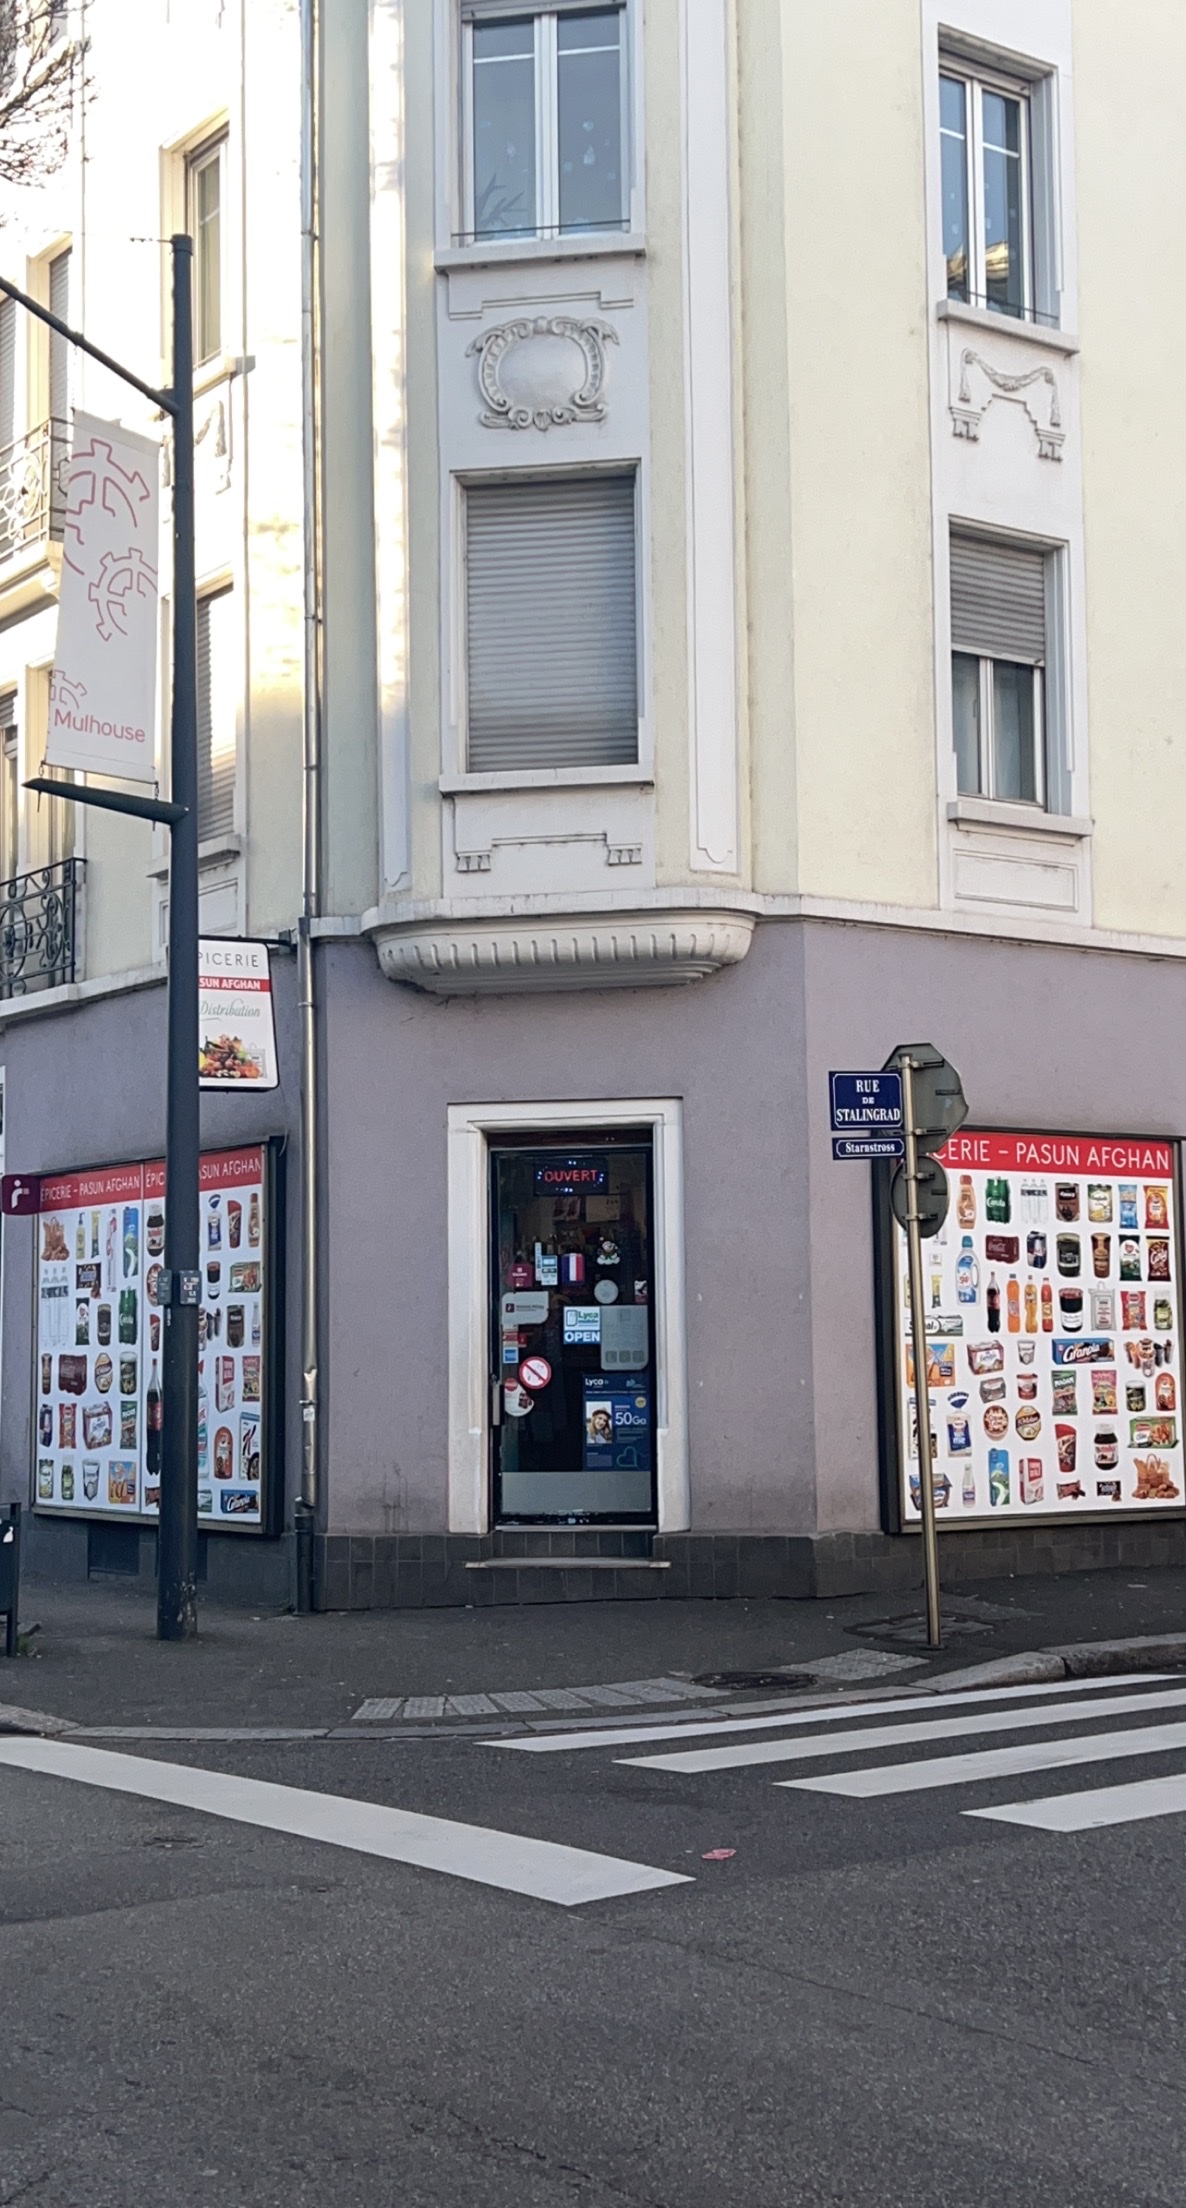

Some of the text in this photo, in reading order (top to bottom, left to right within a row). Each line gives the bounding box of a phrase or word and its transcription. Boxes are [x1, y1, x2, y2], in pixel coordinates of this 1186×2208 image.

[54, 708, 146, 742] Mulhouse
[198, 952, 259, 967] PICERIE
[199, 977, 261, 990] SUN AFGHAN
[200, 999, 261, 1019] Distribution
[856, 1080, 880, 1093] RUE
[862, 1097, 875, 1105] DE
[836, 1108, 901, 1122] STALINGRAD
[845, 1141, 895, 1153] Starnstross
[1016, 1141, 1080, 1166] PASUN
[1086, 1146, 1169, 1171] AFGHAN
[146, 1158, 261, 1188] ÉPIC SUN AFGHAN
[544, 1169, 598, 1182] OUVERT
[79, 1181, 105, 1197] PASUN
[106, 1175, 140, 1192] AFGHAN
[578, 1311, 599, 1321] Lyca
[564, 1332, 600, 1343] OPEN
[585, 1377, 604, 1387] Lyca
